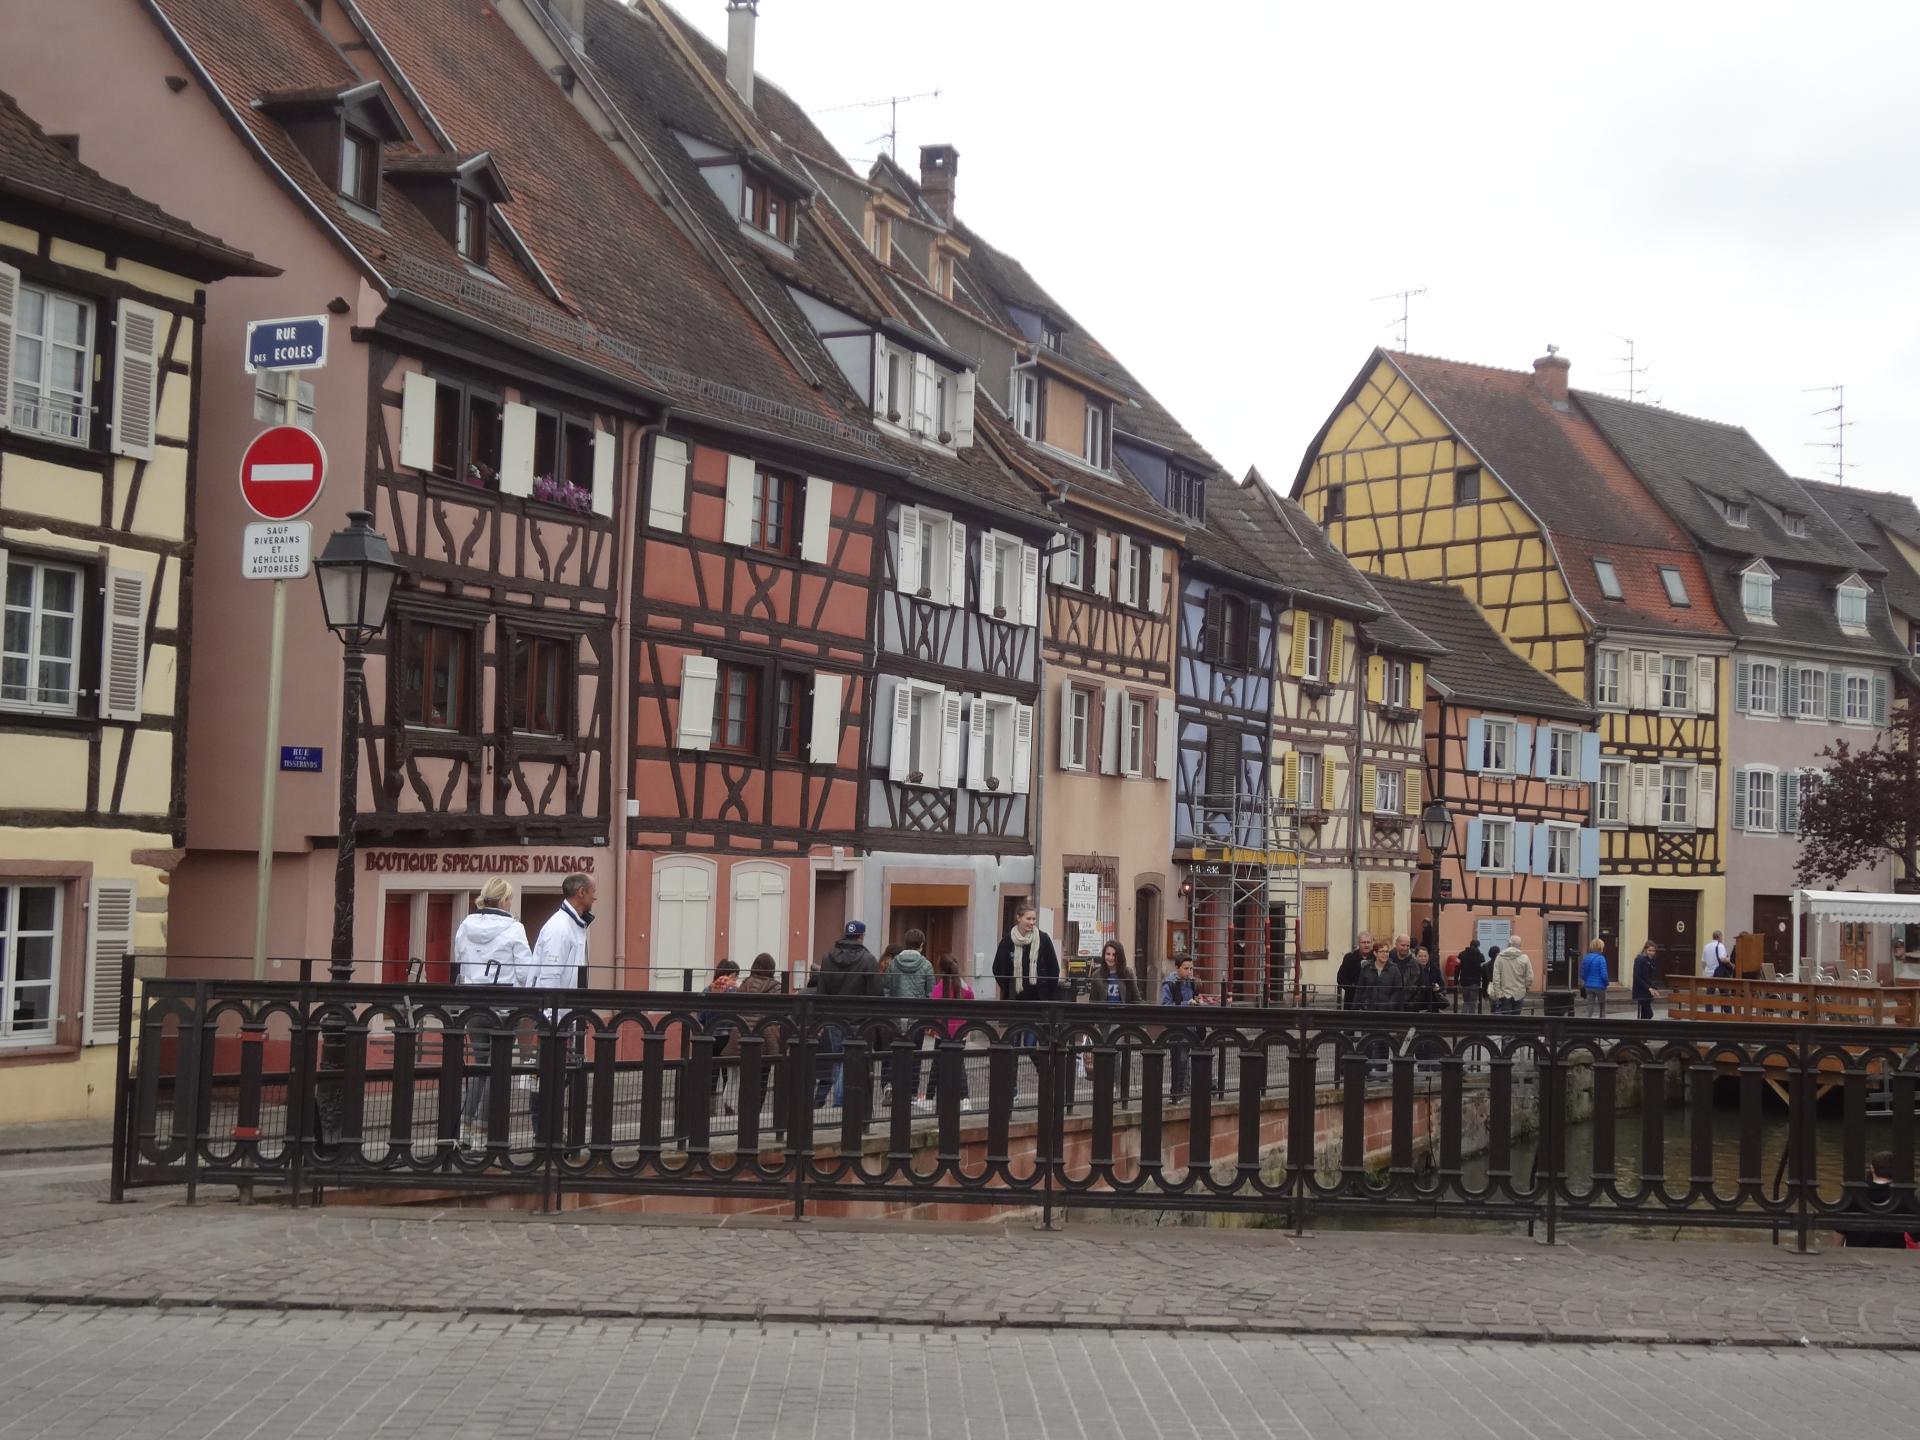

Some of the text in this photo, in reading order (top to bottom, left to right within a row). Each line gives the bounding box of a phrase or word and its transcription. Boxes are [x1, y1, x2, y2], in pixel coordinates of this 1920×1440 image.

[276, 327, 297, 340] RUE
[254, 345, 314, 362] DES ECOLES
[267, 526, 289, 535] SAUF
[254, 535, 301, 545] RIVERAINS
[271, 545, 282, 554] ET
[252, 554, 300, 564] VÉHICULES
[252, 563, 300, 574] AUTORISÉS
[293, 748, 310, 756] RUE
[365, 851, 594, 873] BOUTIQUE SPECIALITES D'ALSACE
